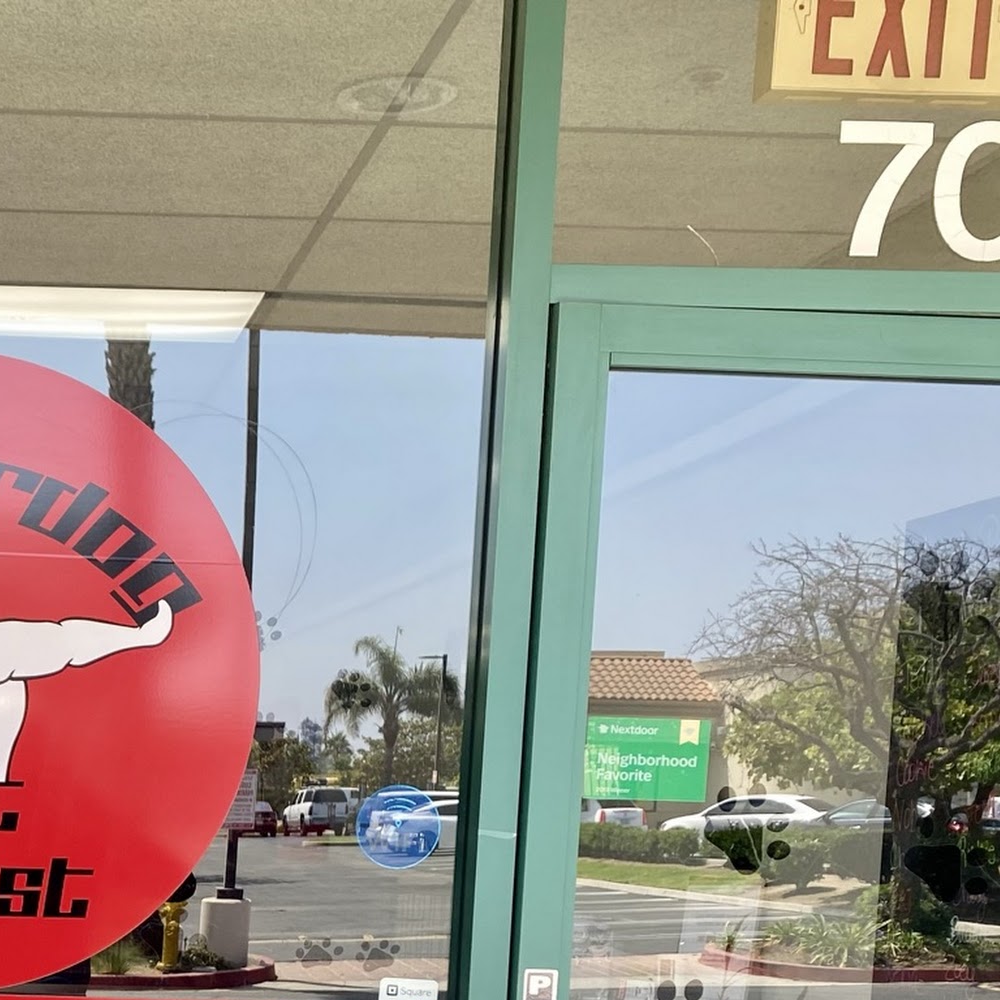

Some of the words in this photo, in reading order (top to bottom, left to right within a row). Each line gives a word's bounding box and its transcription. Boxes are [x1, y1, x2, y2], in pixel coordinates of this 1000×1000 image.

[610, 725, 659, 735] Nextdoor
[597, 752, 698, 767] Neighborhood
[596, 768, 653, 782] Favorite
[400, 986, 432, 998] Square
